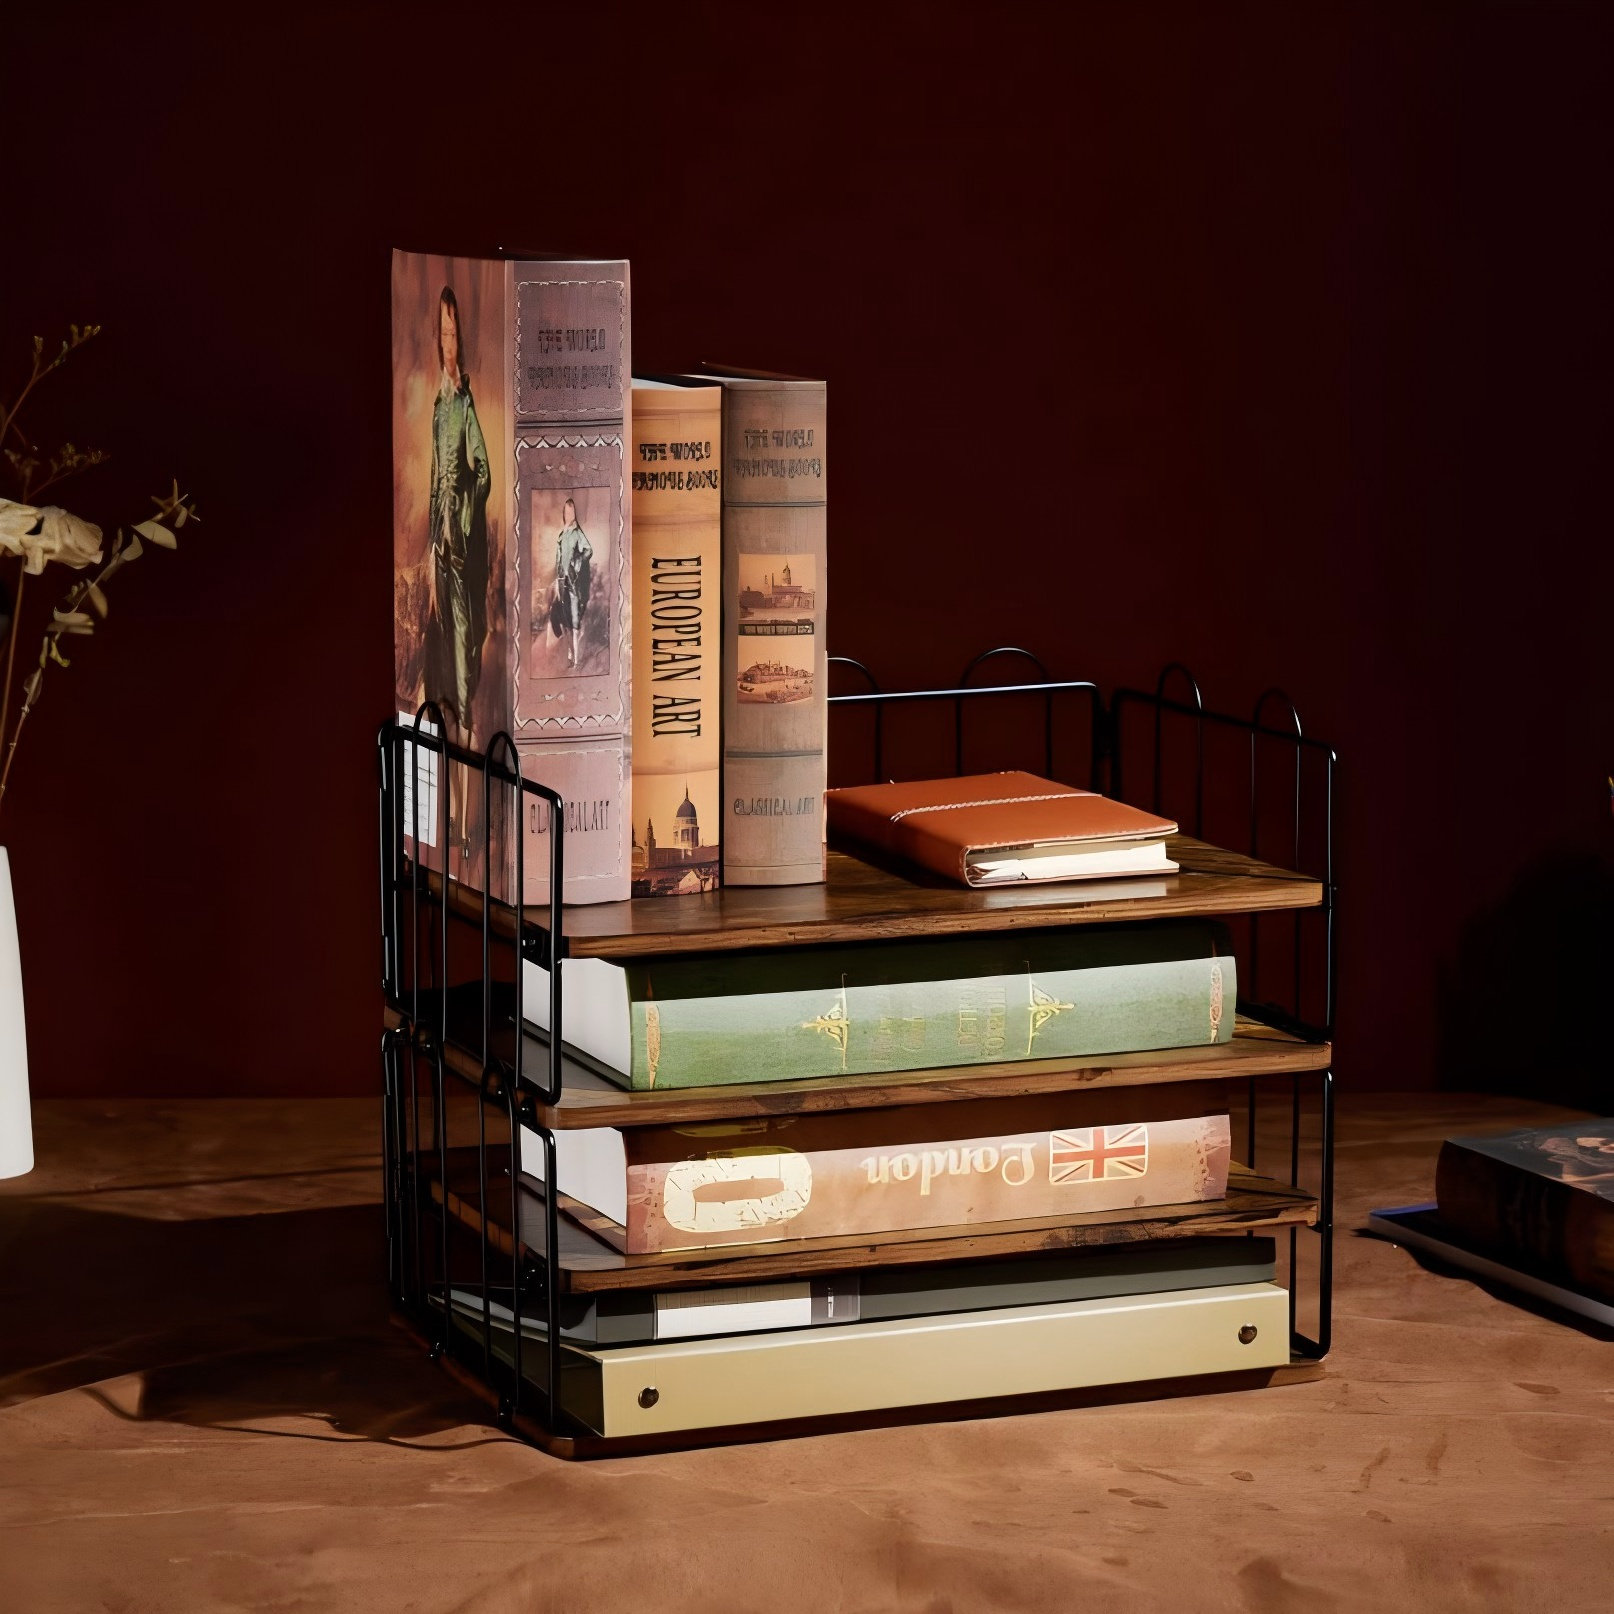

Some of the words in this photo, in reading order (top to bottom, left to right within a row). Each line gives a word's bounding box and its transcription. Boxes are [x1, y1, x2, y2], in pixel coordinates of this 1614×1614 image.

[650, 555, 703, 682] EUROPEAN
[651, 694, 702, 738] ART
[859, 1142, 1037, 1196] London
